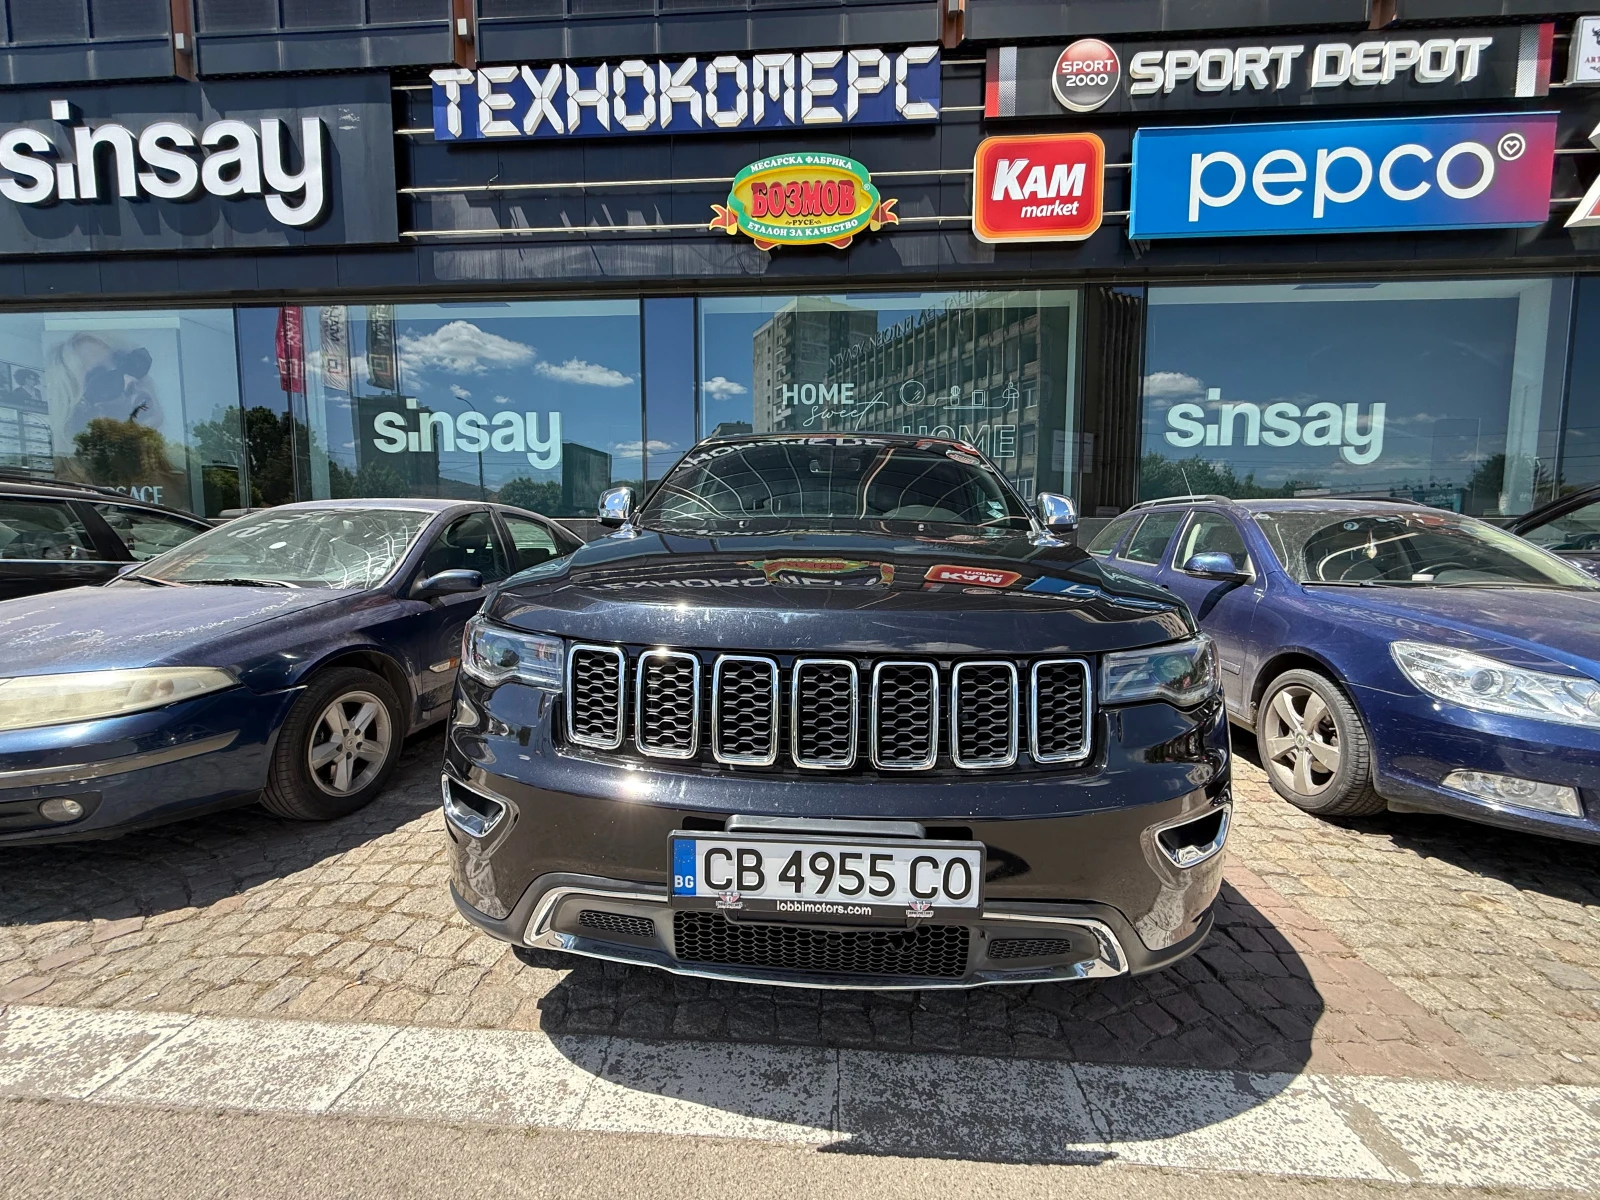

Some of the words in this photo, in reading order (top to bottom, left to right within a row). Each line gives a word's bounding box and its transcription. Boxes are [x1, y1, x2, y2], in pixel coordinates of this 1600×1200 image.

[1061, 58, 1115, 75] SPORT
[1065, 73, 1108, 87] 2000
[1130, 45, 1304, 95] SPORT
[1312, 36, 1494, 88] DEPOT
[429, 45, 940, 139] ТЕХНОКОМЕРС
[0, 100, 325, 226] sinsay
[751, 156, 803, 173] МЕСАРСКА
[805, 156, 853, 170] ФАБРИКА
[991, 158, 1087, 201] KAM
[751, 180, 856, 217] БОЗМОВ
[1189, 142, 1495, 223] pepco
[1021, 200, 1079, 218] market
[747, 222, 787, 237] ЕТАЛОН
[805, 219, 858, 236] КАЧЕСТВО
[782, 383, 854, 405] HOME
[373, 398, 562, 470] sinsay
[1164, 387, 1386, 465] sinsay
[674, 875, 694, 888] BG
[778, 851, 896, 897] 4955
[776, 900, 872, 916] lobbimotors.com
